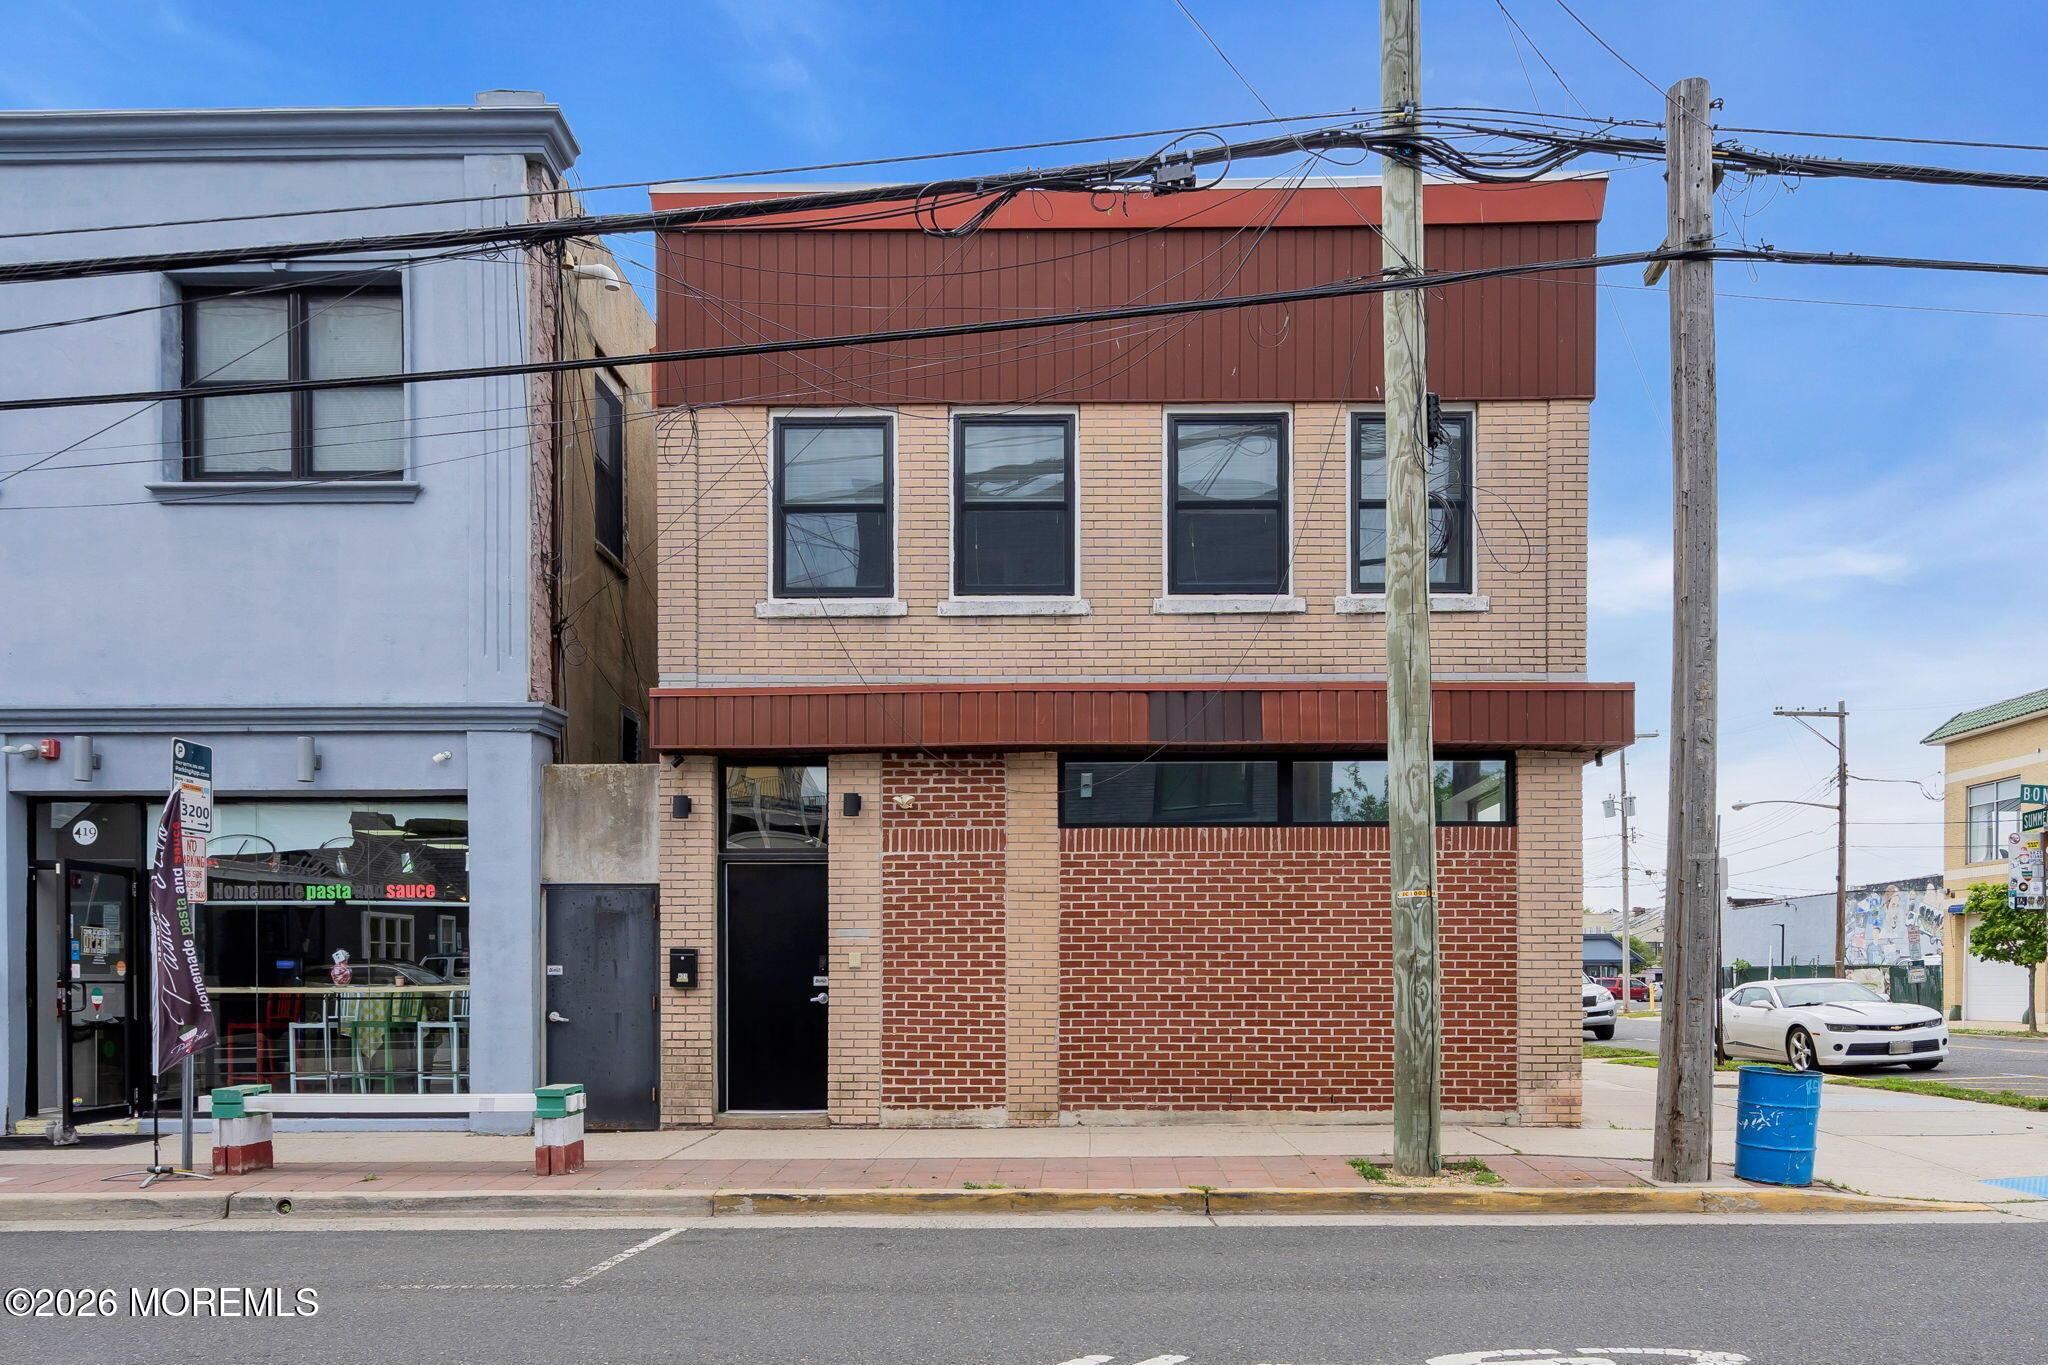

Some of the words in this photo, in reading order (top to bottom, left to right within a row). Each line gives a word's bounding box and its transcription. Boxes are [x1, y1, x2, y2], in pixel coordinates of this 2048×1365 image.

[74, 827, 97, 839] 419
[172, 821, 182, 864] sauce
[186, 840, 198, 853] NO
[172, 867, 186, 894] and
[185, 880, 202, 889] ESDAY
[212, 882, 305, 900] Homemade
[306, 883, 352, 900] pasta
[385, 884, 436, 899] sauce
[176, 897, 193, 936] pasta
[182, 939, 212, 1013] Homemade
